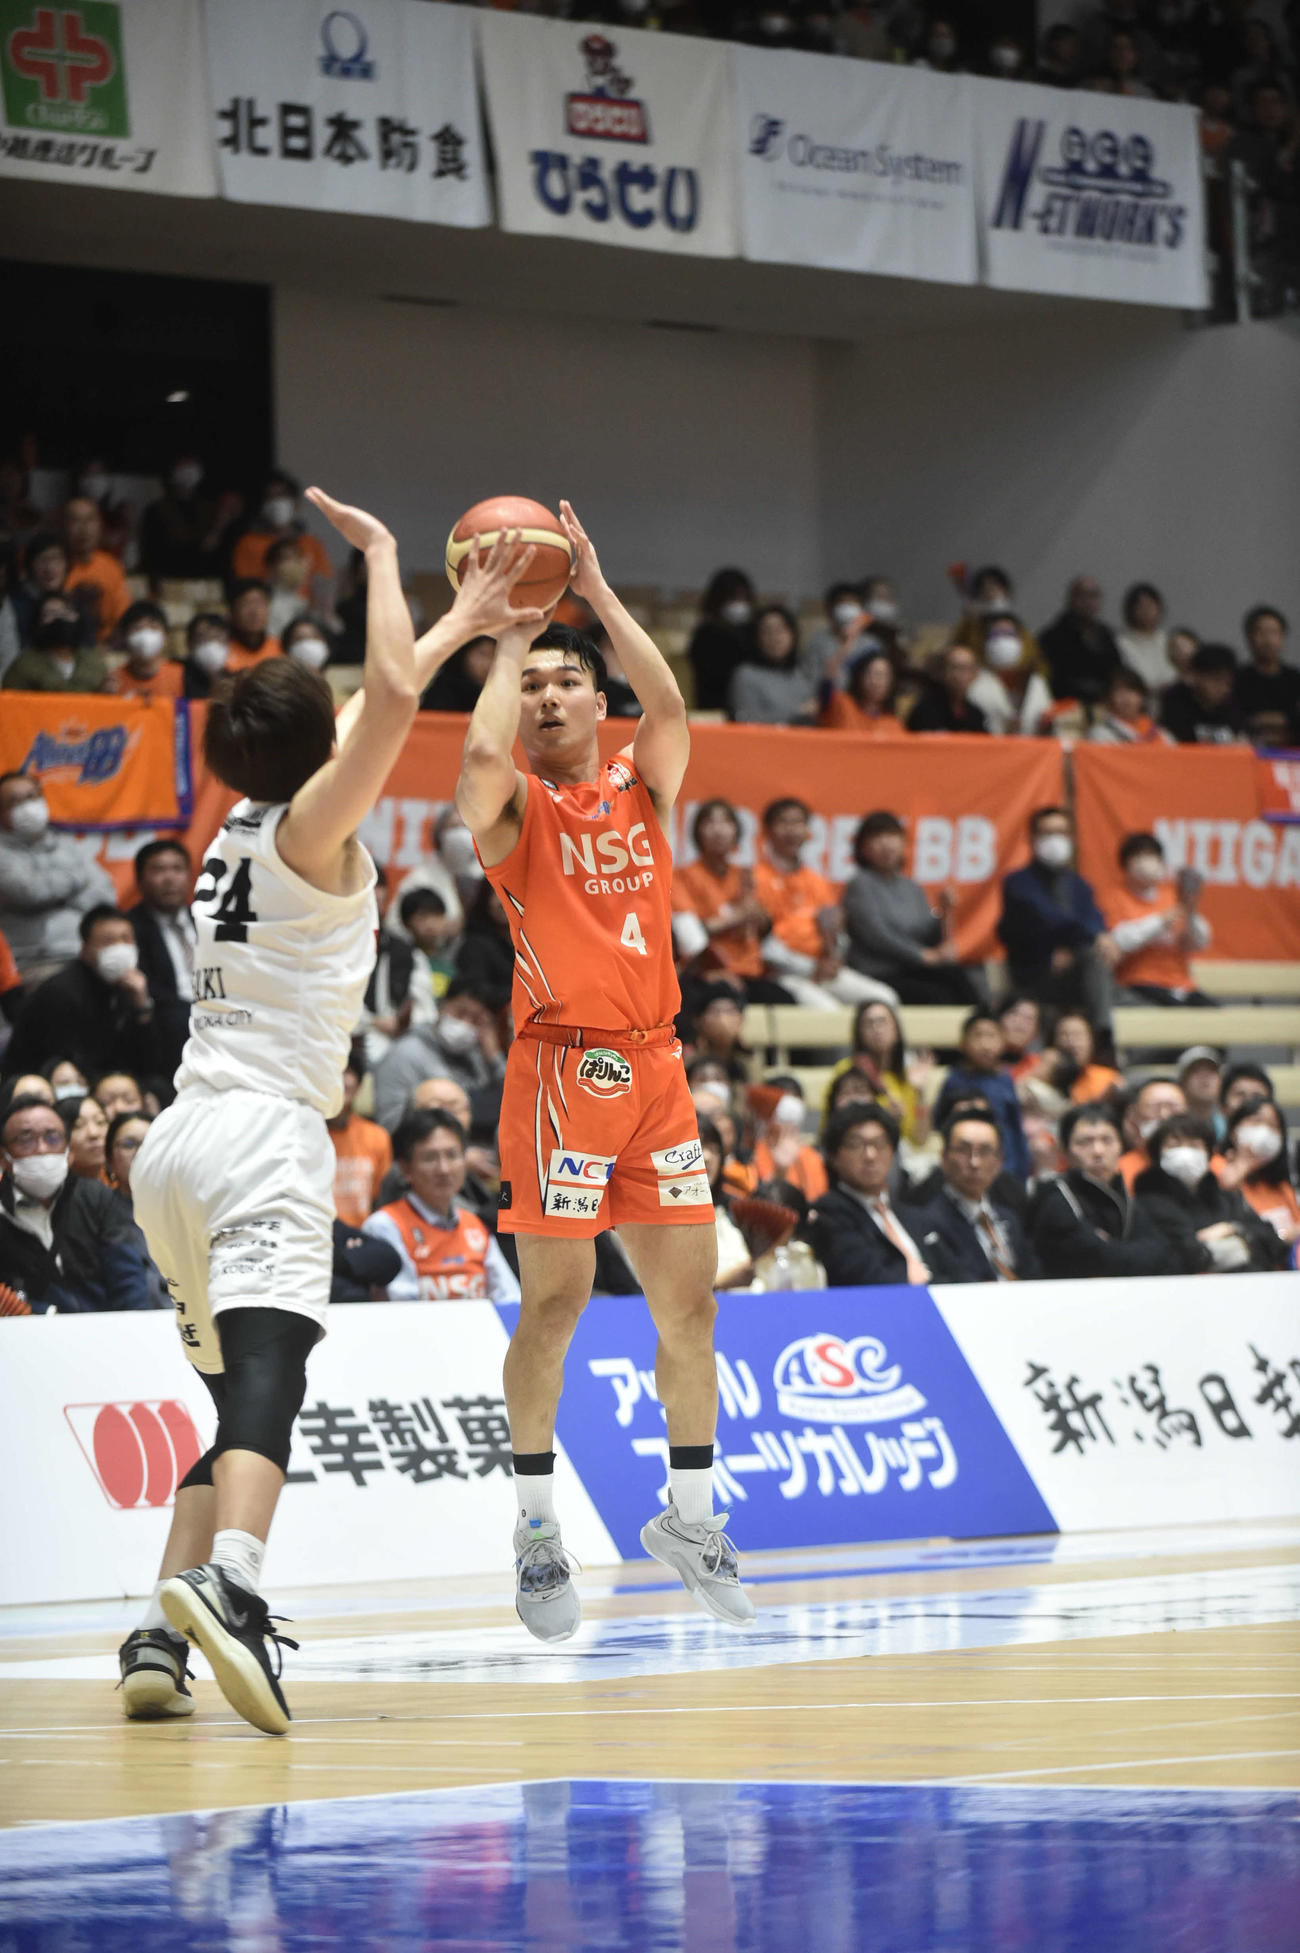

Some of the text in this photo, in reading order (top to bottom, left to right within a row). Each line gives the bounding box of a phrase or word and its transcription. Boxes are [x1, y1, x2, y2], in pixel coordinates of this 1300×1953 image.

[217, 96, 471, 182] 北日本防食
[530, 150, 700, 233] ひらせい
[560, 822, 655, 877] NSG
[584, 871, 655, 896] GROUP
[915, 814, 995, 886] BB
[194, 857, 259, 944] 24
[620, 911, 648, 956] 4
[579, 1056, 631, 1083] ぱりんこ
[284, 1396, 514, 1487] 幸製菓
